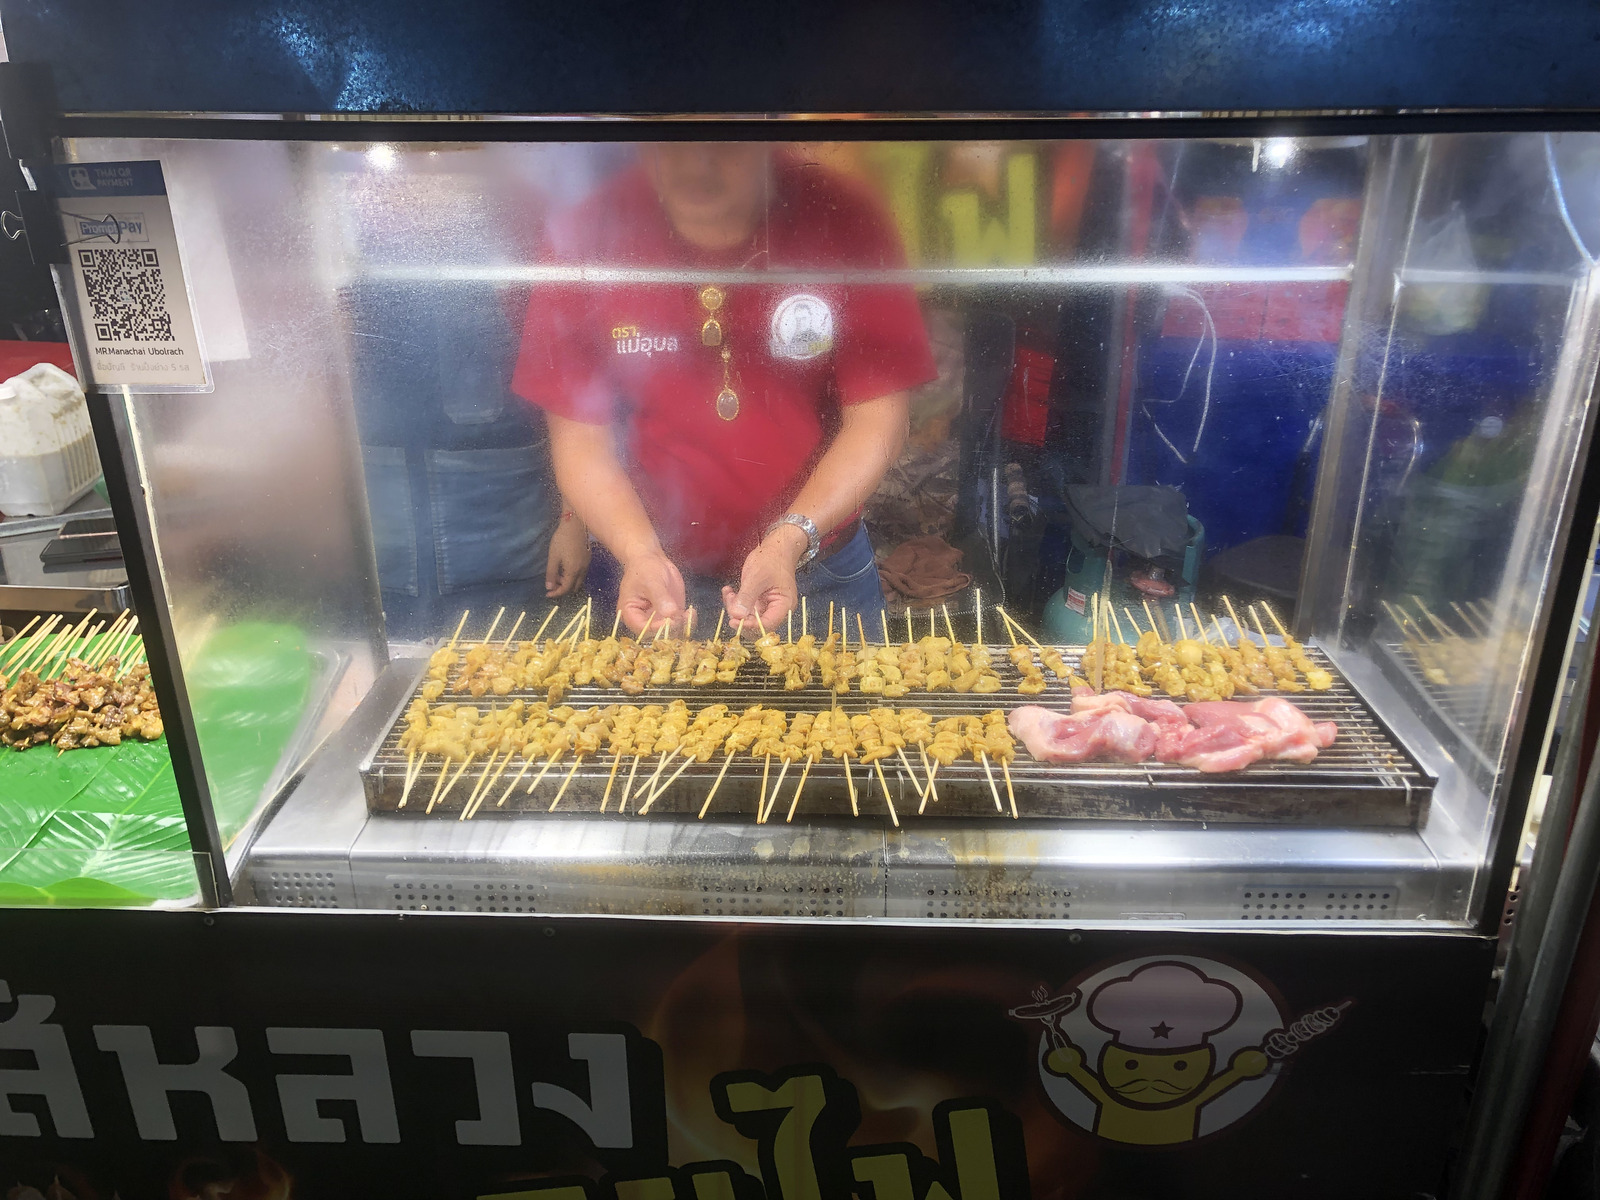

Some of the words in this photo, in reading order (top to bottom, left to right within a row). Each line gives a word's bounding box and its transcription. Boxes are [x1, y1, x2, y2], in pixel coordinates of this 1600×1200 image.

[95, 168, 119, 178] THAI
[121, 167, 132, 177] QR
[96, 178, 134, 188] PAYMENT
[148, 346, 185, 356] Ubolrach
